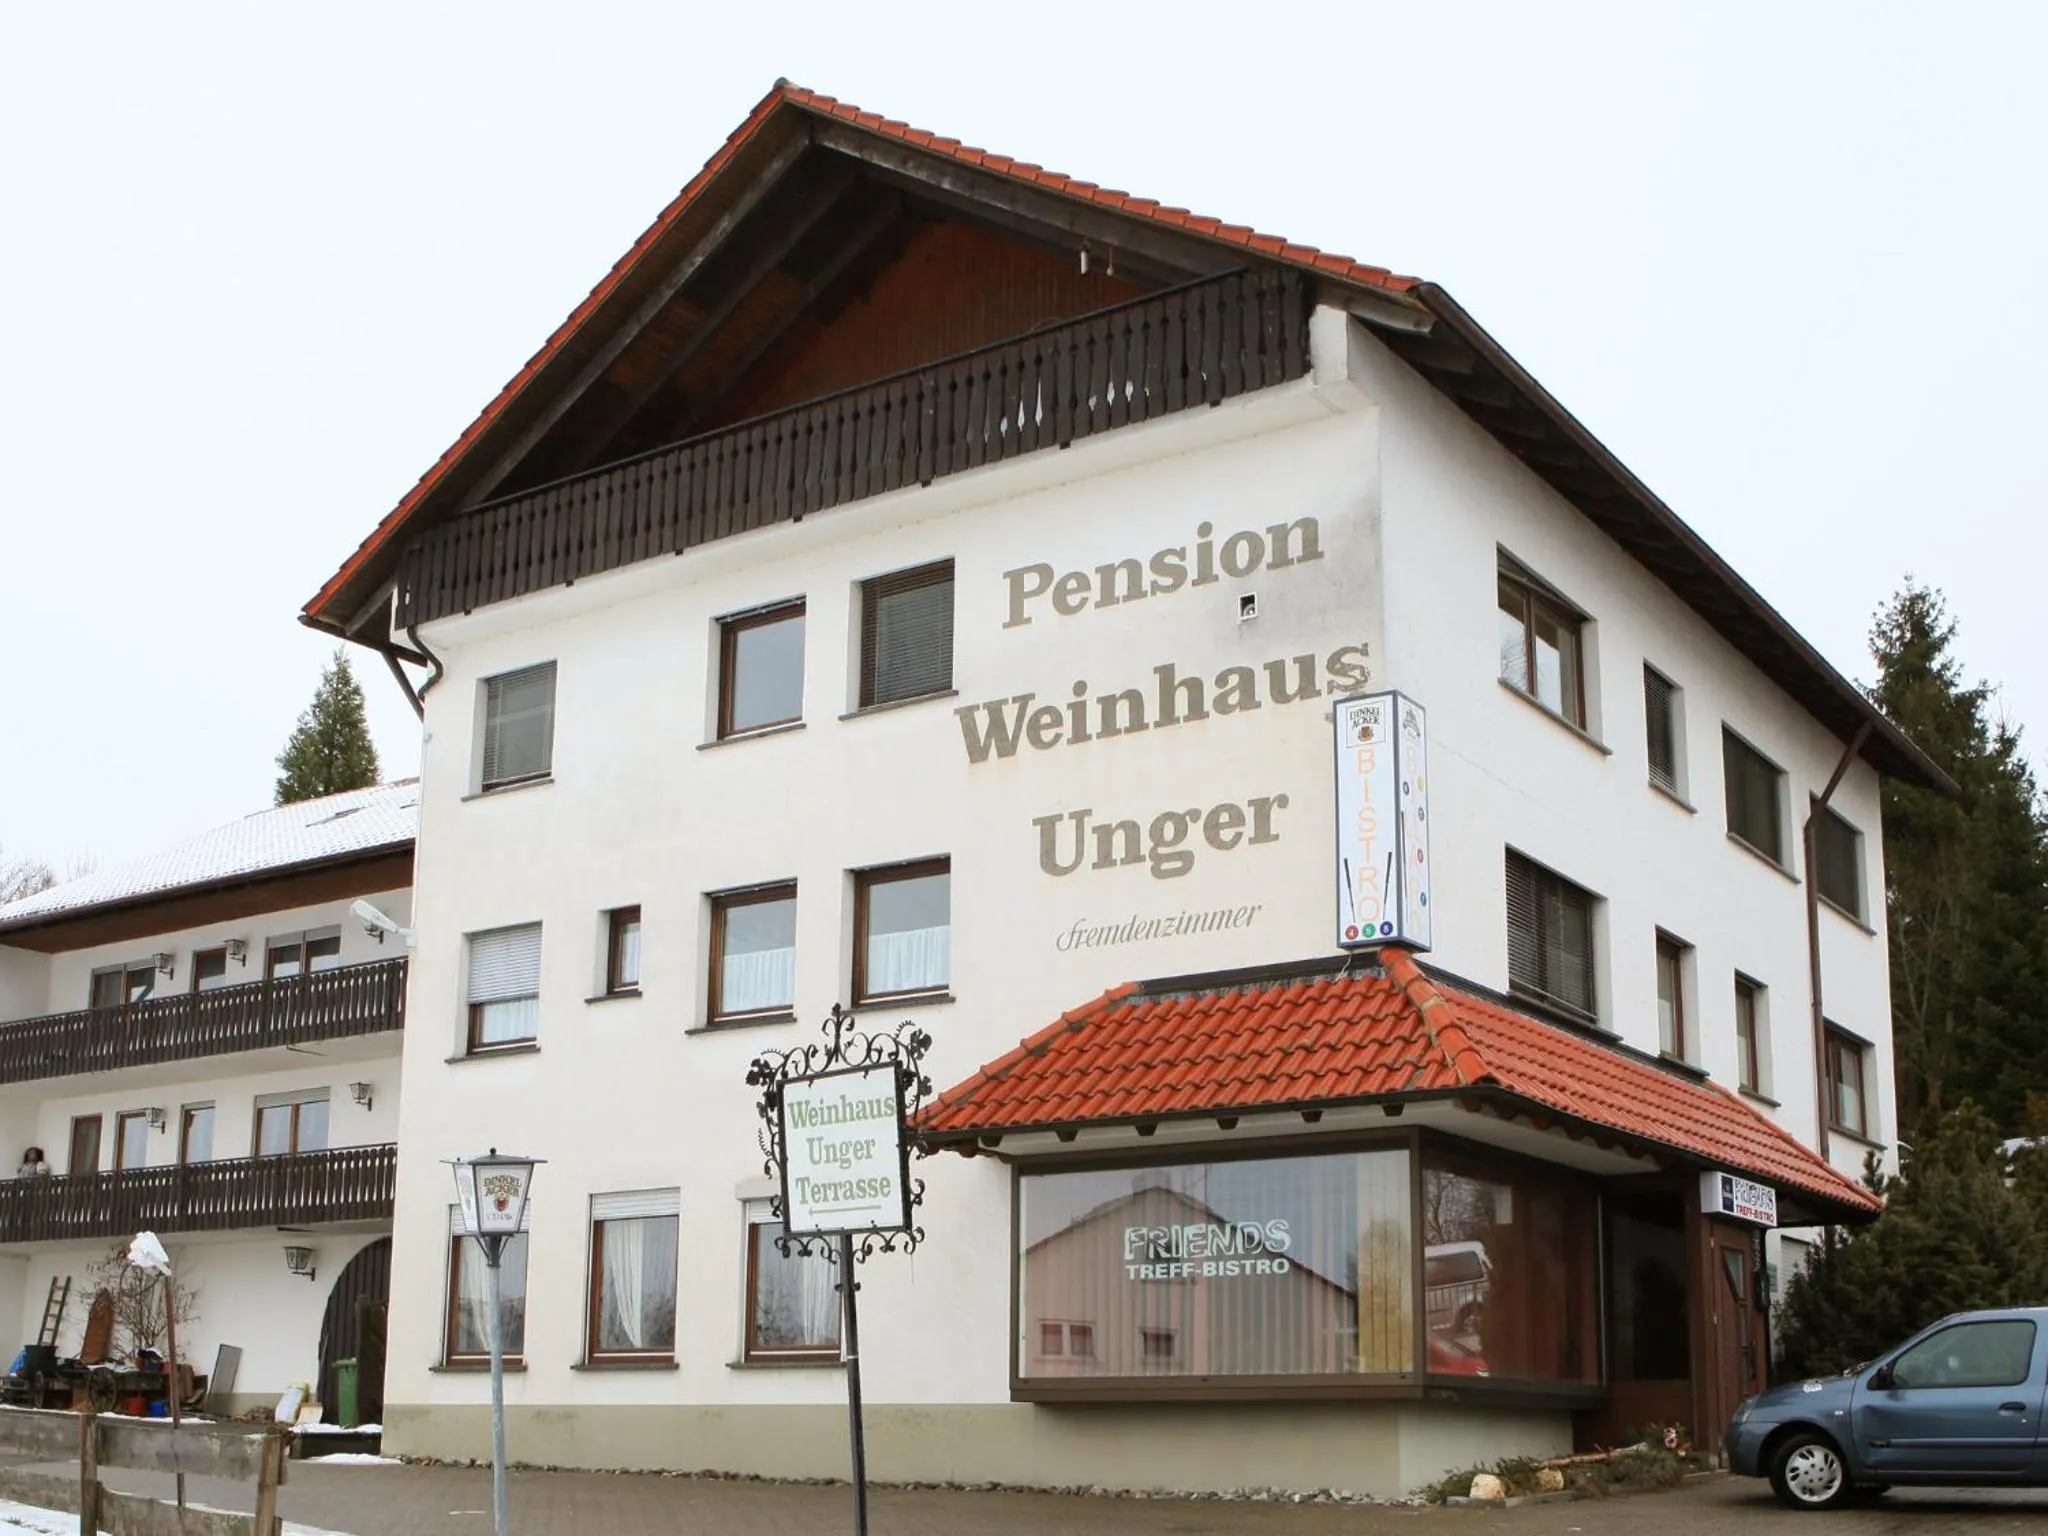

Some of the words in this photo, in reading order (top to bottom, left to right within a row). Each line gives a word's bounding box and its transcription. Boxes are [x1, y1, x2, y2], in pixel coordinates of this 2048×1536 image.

[1002, 515, 1325, 629] Pension
[953, 642, 1371, 764] Weinhaus
[1032, 793, 1290, 880] Unger
[1357, 748, 1380, 923] BISTRO
[787, 1094, 897, 1130] Weinhaus
[806, 1136, 876, 1169] Unger
[796, 1175, 891, 1205] Terrasse
[1124, 1219, 1292, 1260] FRIENDS
[1125, 1258, 1290, 1280] TREFF-BISTRO
